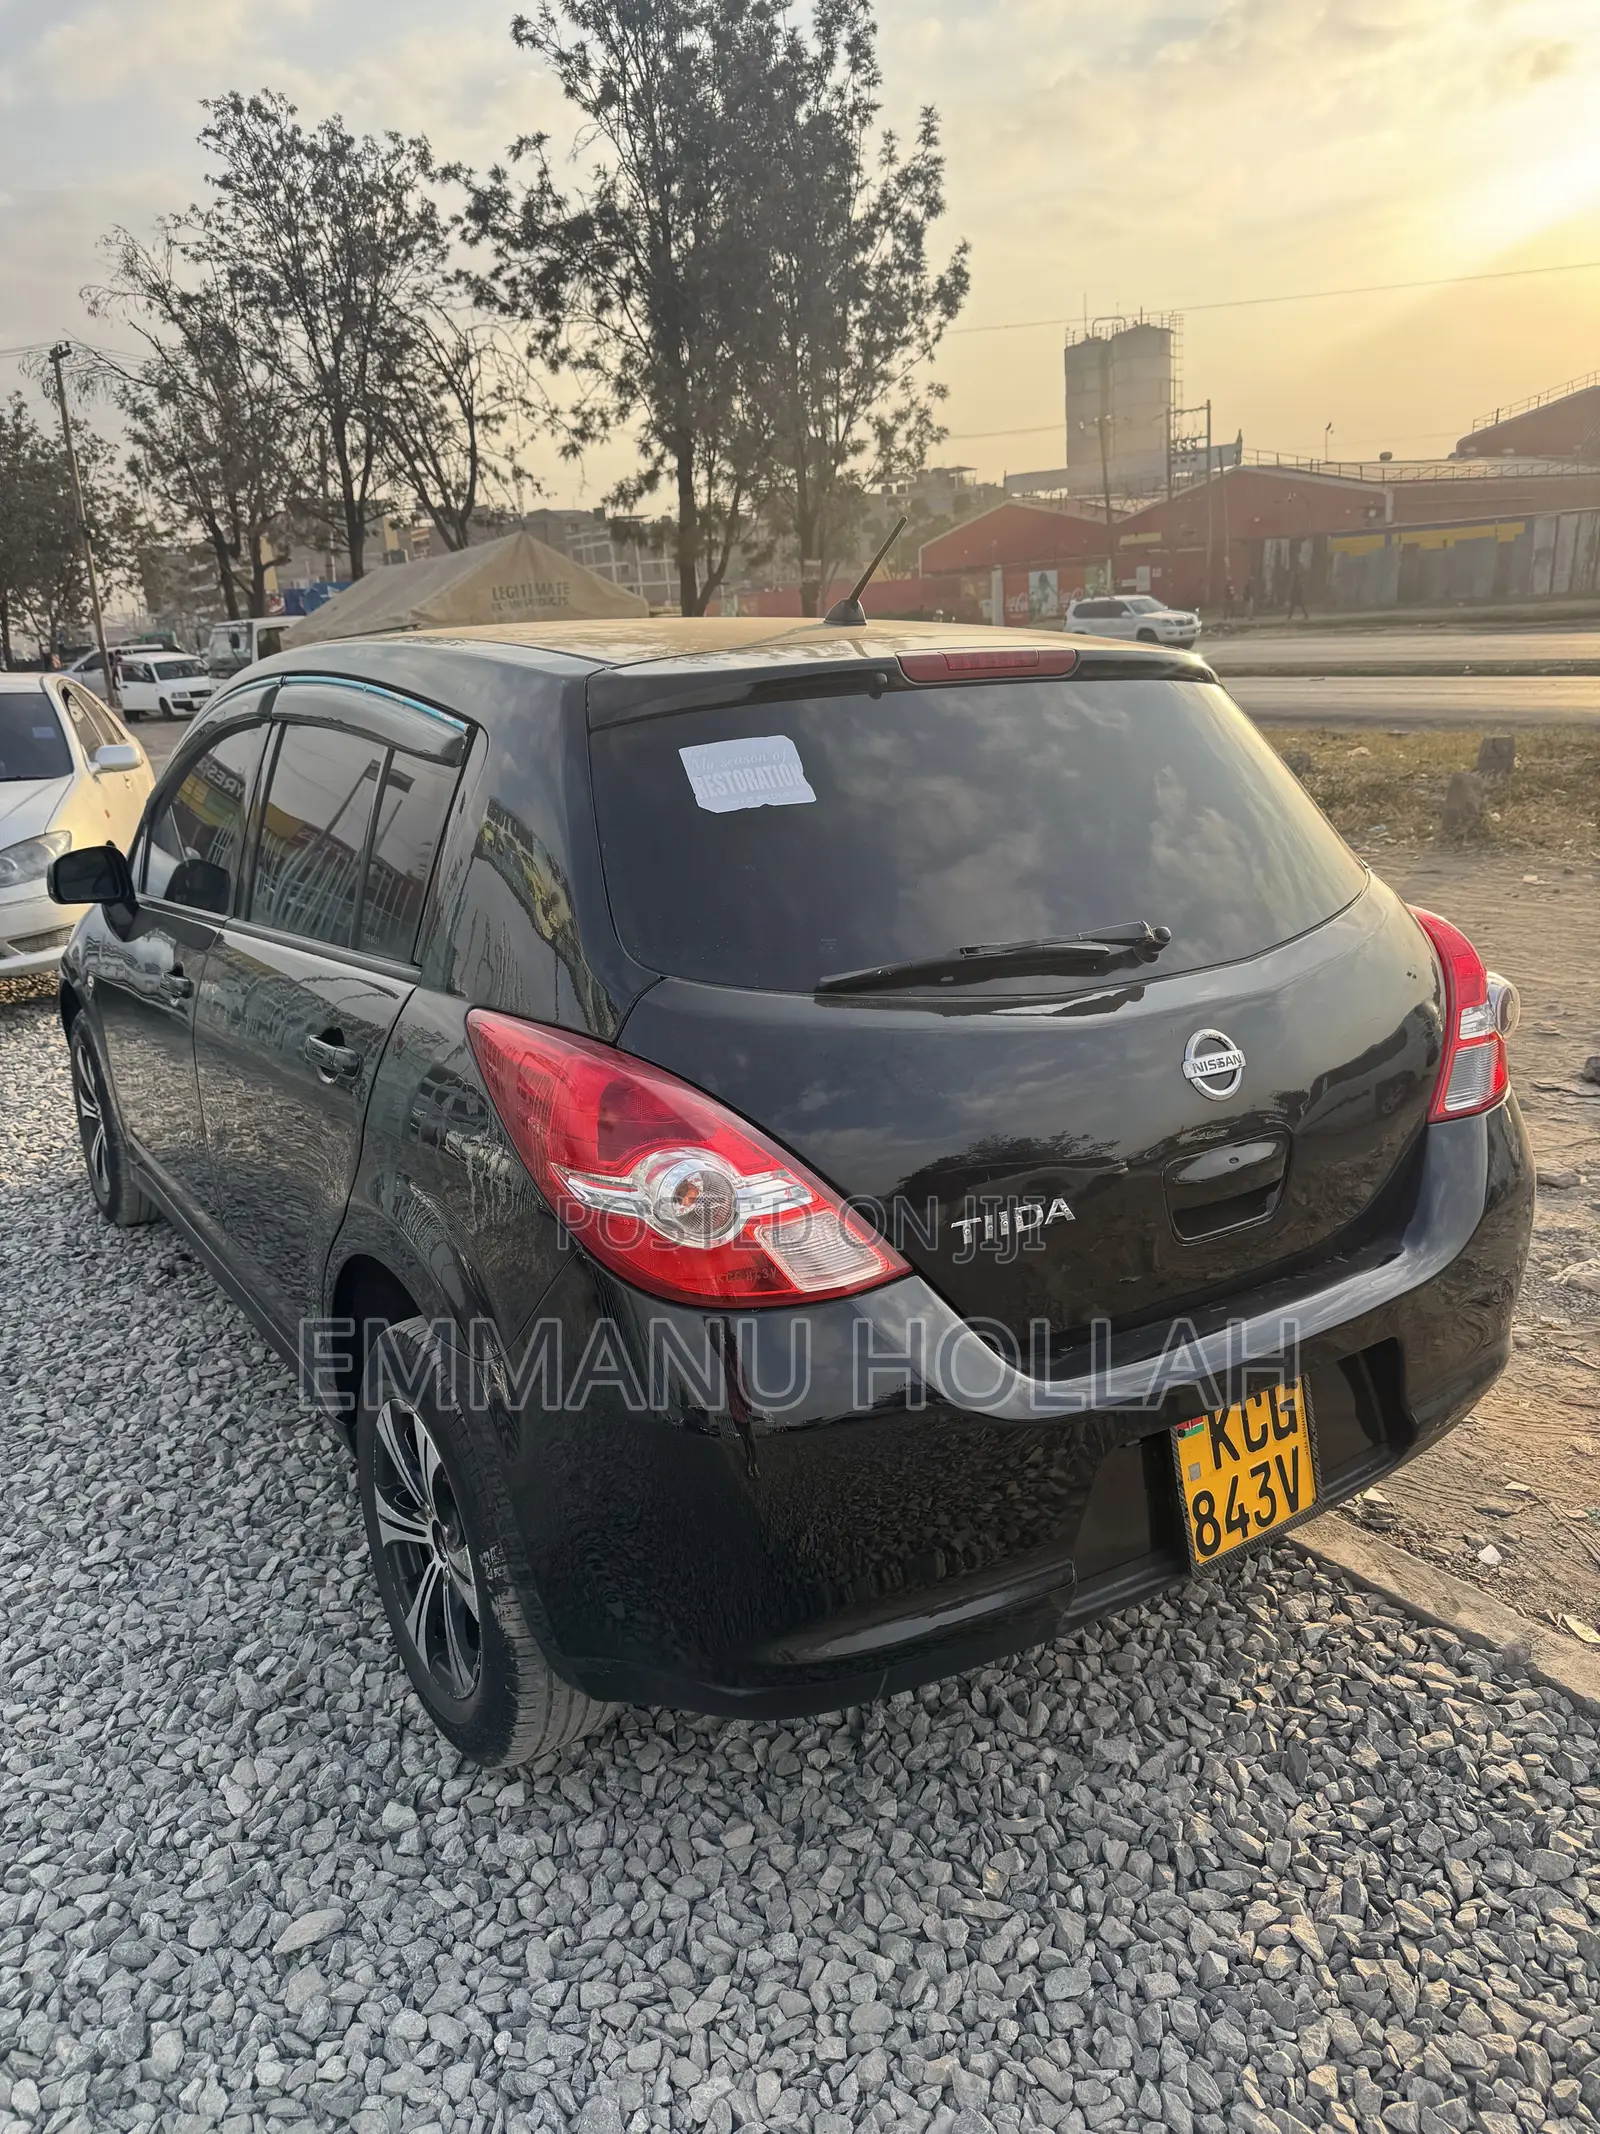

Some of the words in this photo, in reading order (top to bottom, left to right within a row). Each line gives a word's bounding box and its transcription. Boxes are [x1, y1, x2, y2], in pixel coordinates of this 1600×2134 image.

[492, 581, 570, 601] LEGITIMATE
[691, 757, 714, 773] My
[720, 753, 767, 768] season
[772, 746, 788, 765] of
[691, 763, 804, 800] RESTORATION
[1192, 1053, 1242, 1074] NISSAN
[951, 1197, 1076, 1245] TIIDA
[1208, 1381, 1299, 1470] KCG
[1192, 1446, 1299, 1556] 843V
